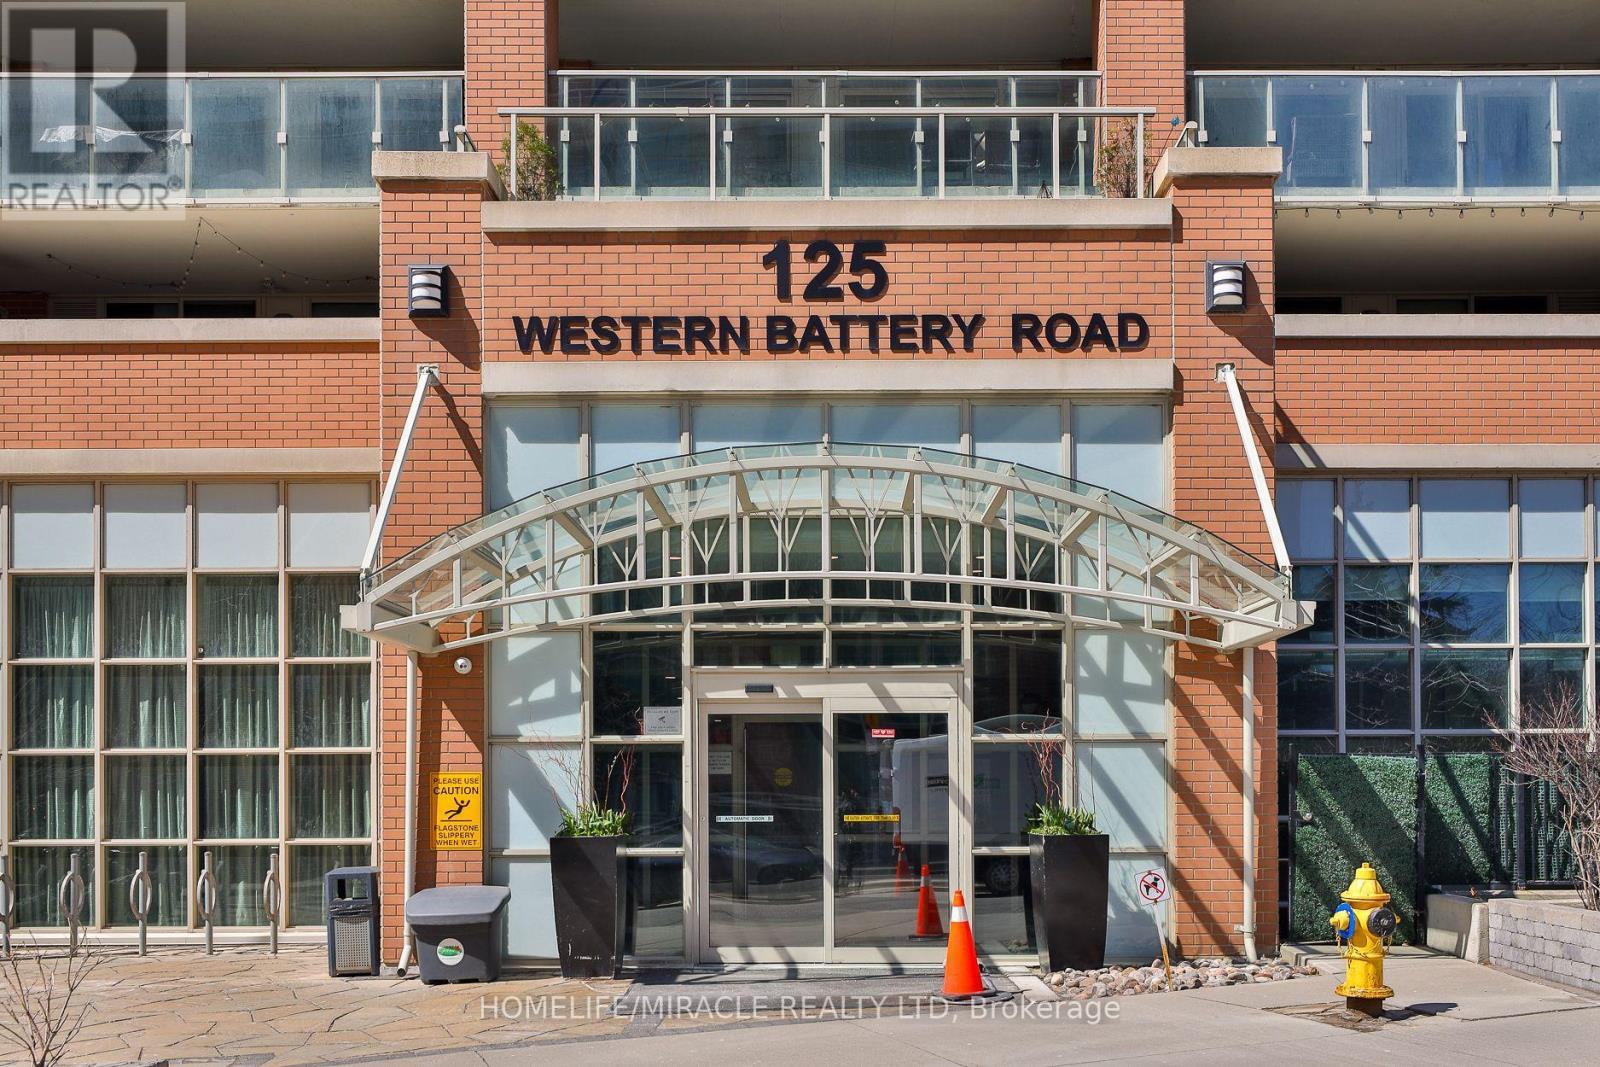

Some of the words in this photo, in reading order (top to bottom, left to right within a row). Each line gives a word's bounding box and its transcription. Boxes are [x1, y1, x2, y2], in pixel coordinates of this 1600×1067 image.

[762, 240, 889, 303] 125
[512, 315, 750, 355] WESTERN
[766, 313, 986, 354] BATTERY
[1011, 312, 1150, 353] ROAD
[433, 786, 479, 795] CAUTION
